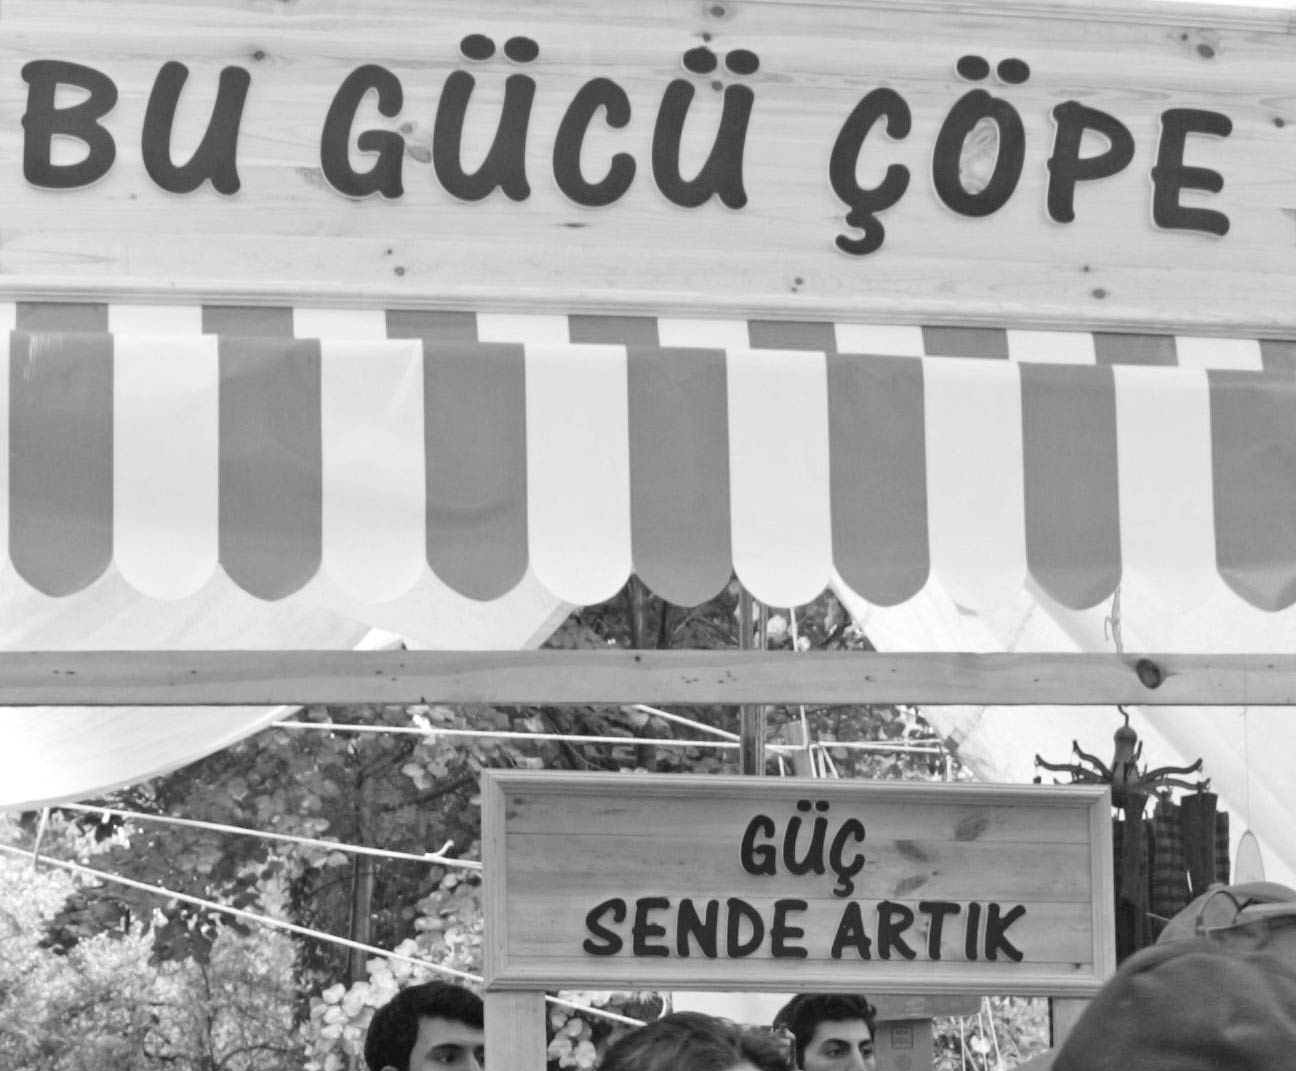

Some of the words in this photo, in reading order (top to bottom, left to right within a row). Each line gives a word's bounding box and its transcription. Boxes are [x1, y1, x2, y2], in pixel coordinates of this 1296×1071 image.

[20, 60, 252, 196] BU
[320, 33, 760, 211] GÜCÜ
[828, 54, 1234, 256] ÇÖPE
[740, 801, 866, 898] GÜÇ
[582, 897, 809, 961] SENDE
[830, 901, 1027, 963] ARTIK
